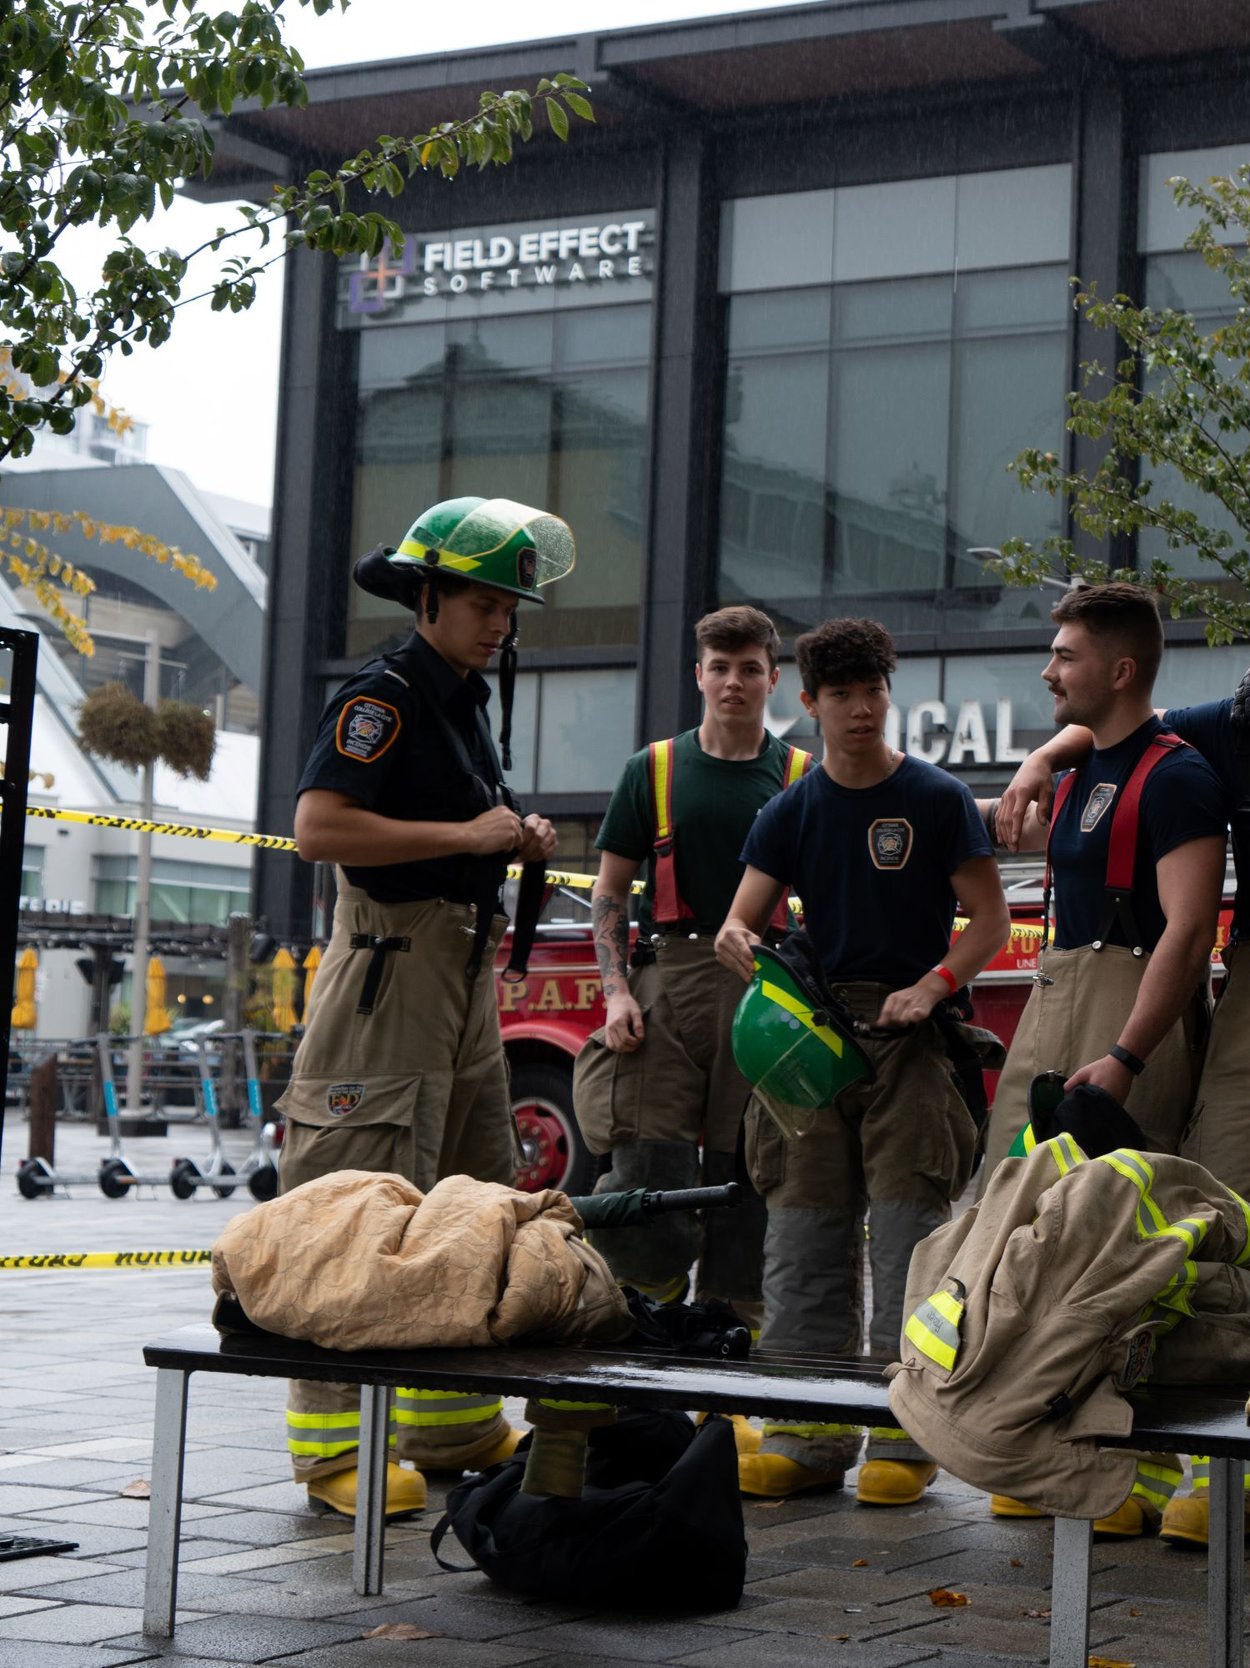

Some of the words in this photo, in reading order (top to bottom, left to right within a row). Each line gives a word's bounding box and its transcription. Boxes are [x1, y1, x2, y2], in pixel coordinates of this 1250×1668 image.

[424, 236, 515, 272] FIELD
[518, 221, 645, 264] EFFECT
[423, 256, 644, 296] SOFTWARE
